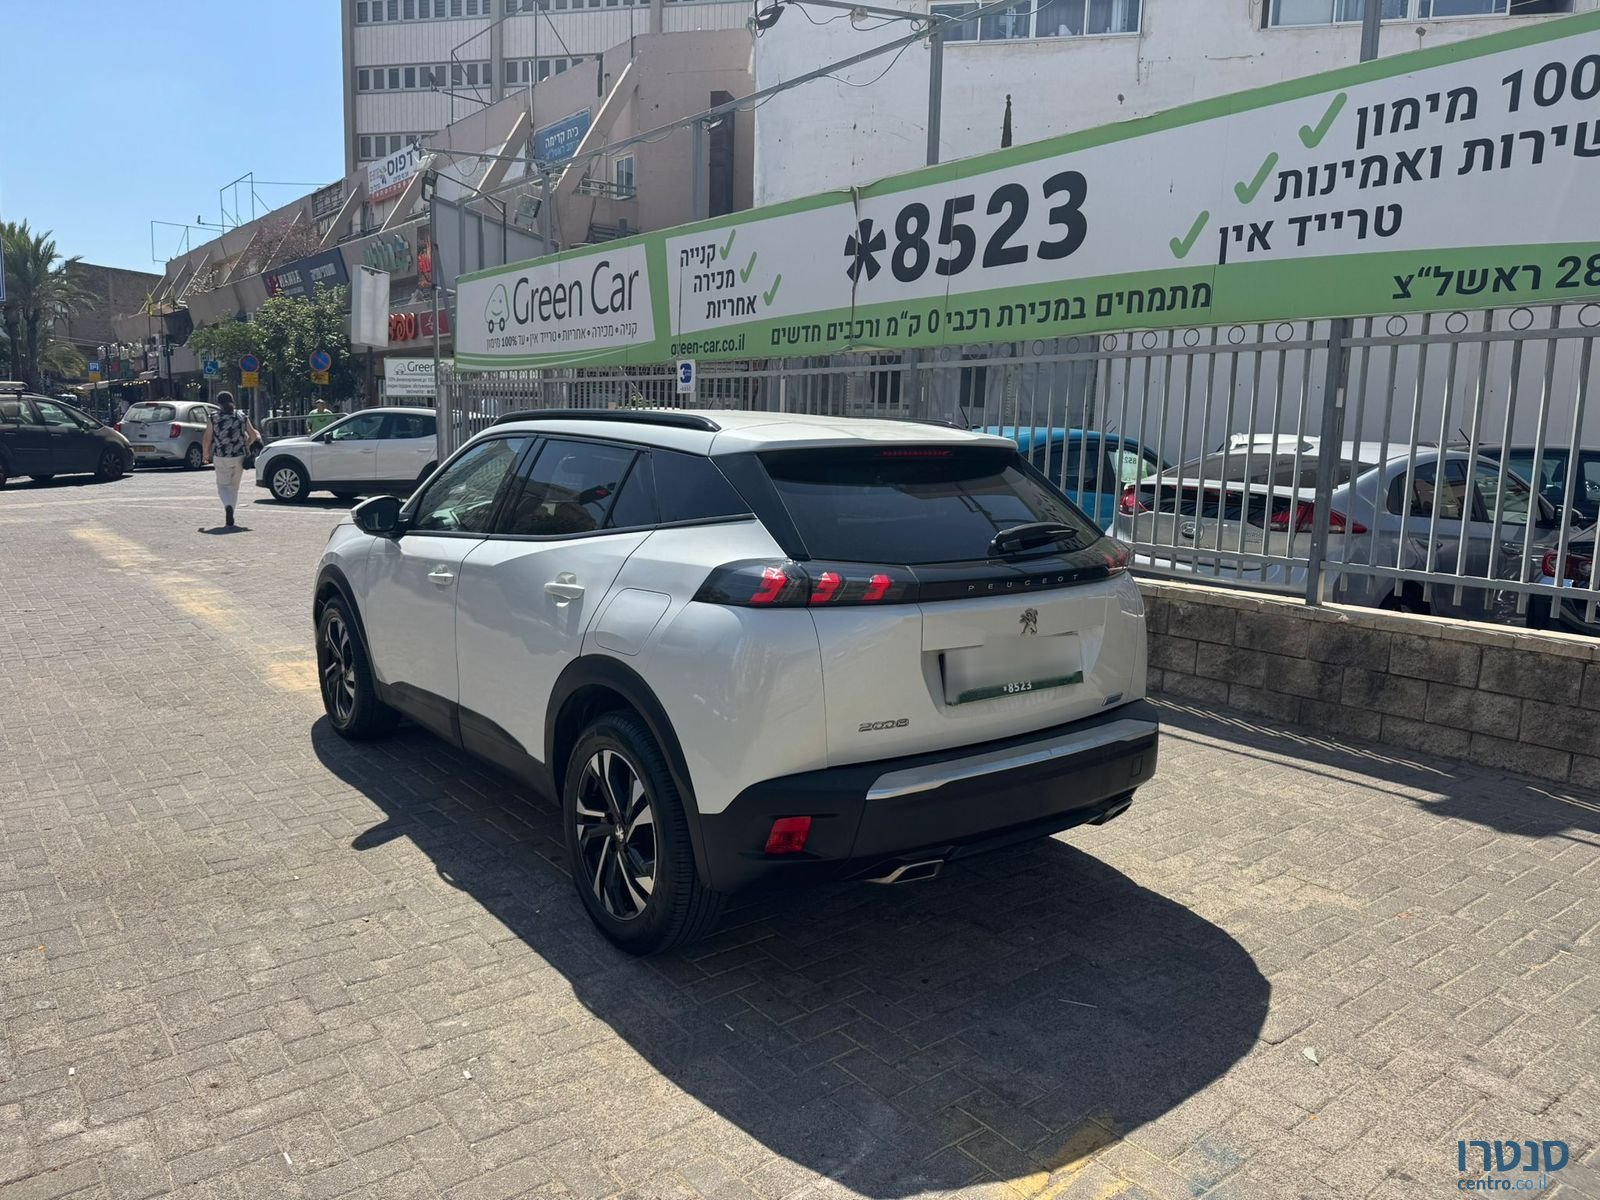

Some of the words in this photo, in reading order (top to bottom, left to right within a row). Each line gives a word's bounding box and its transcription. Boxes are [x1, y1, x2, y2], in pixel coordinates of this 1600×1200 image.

[1356, 86, 1478, 150] מימון
[1274, 144, 1443, 202] ואמינות
[1288, 203, 1403, 246] טרייד
[1219, 220, 1275, 264] אין
[680, 244, 716, 268] קנייה
[513, 277, 583, 325] Green
[590, 260, 639, 315] Car
[694, 269, 735, 293] מכירה
[706, 295, 757, 319] אחריות
[996, 297, 1086, 328] במכירת
[1095, 282, 1212, 318] מתמחים
[826, 317, 881, 341] ורכבים
[927, 309, 940, 334] 0
[946, 307, 991, 332] רכבי
[771, 324, 822, 346] חדשים
[968, 574, 1079, 591] PEUGEOT
[858, 718, 910, 732] 2008
